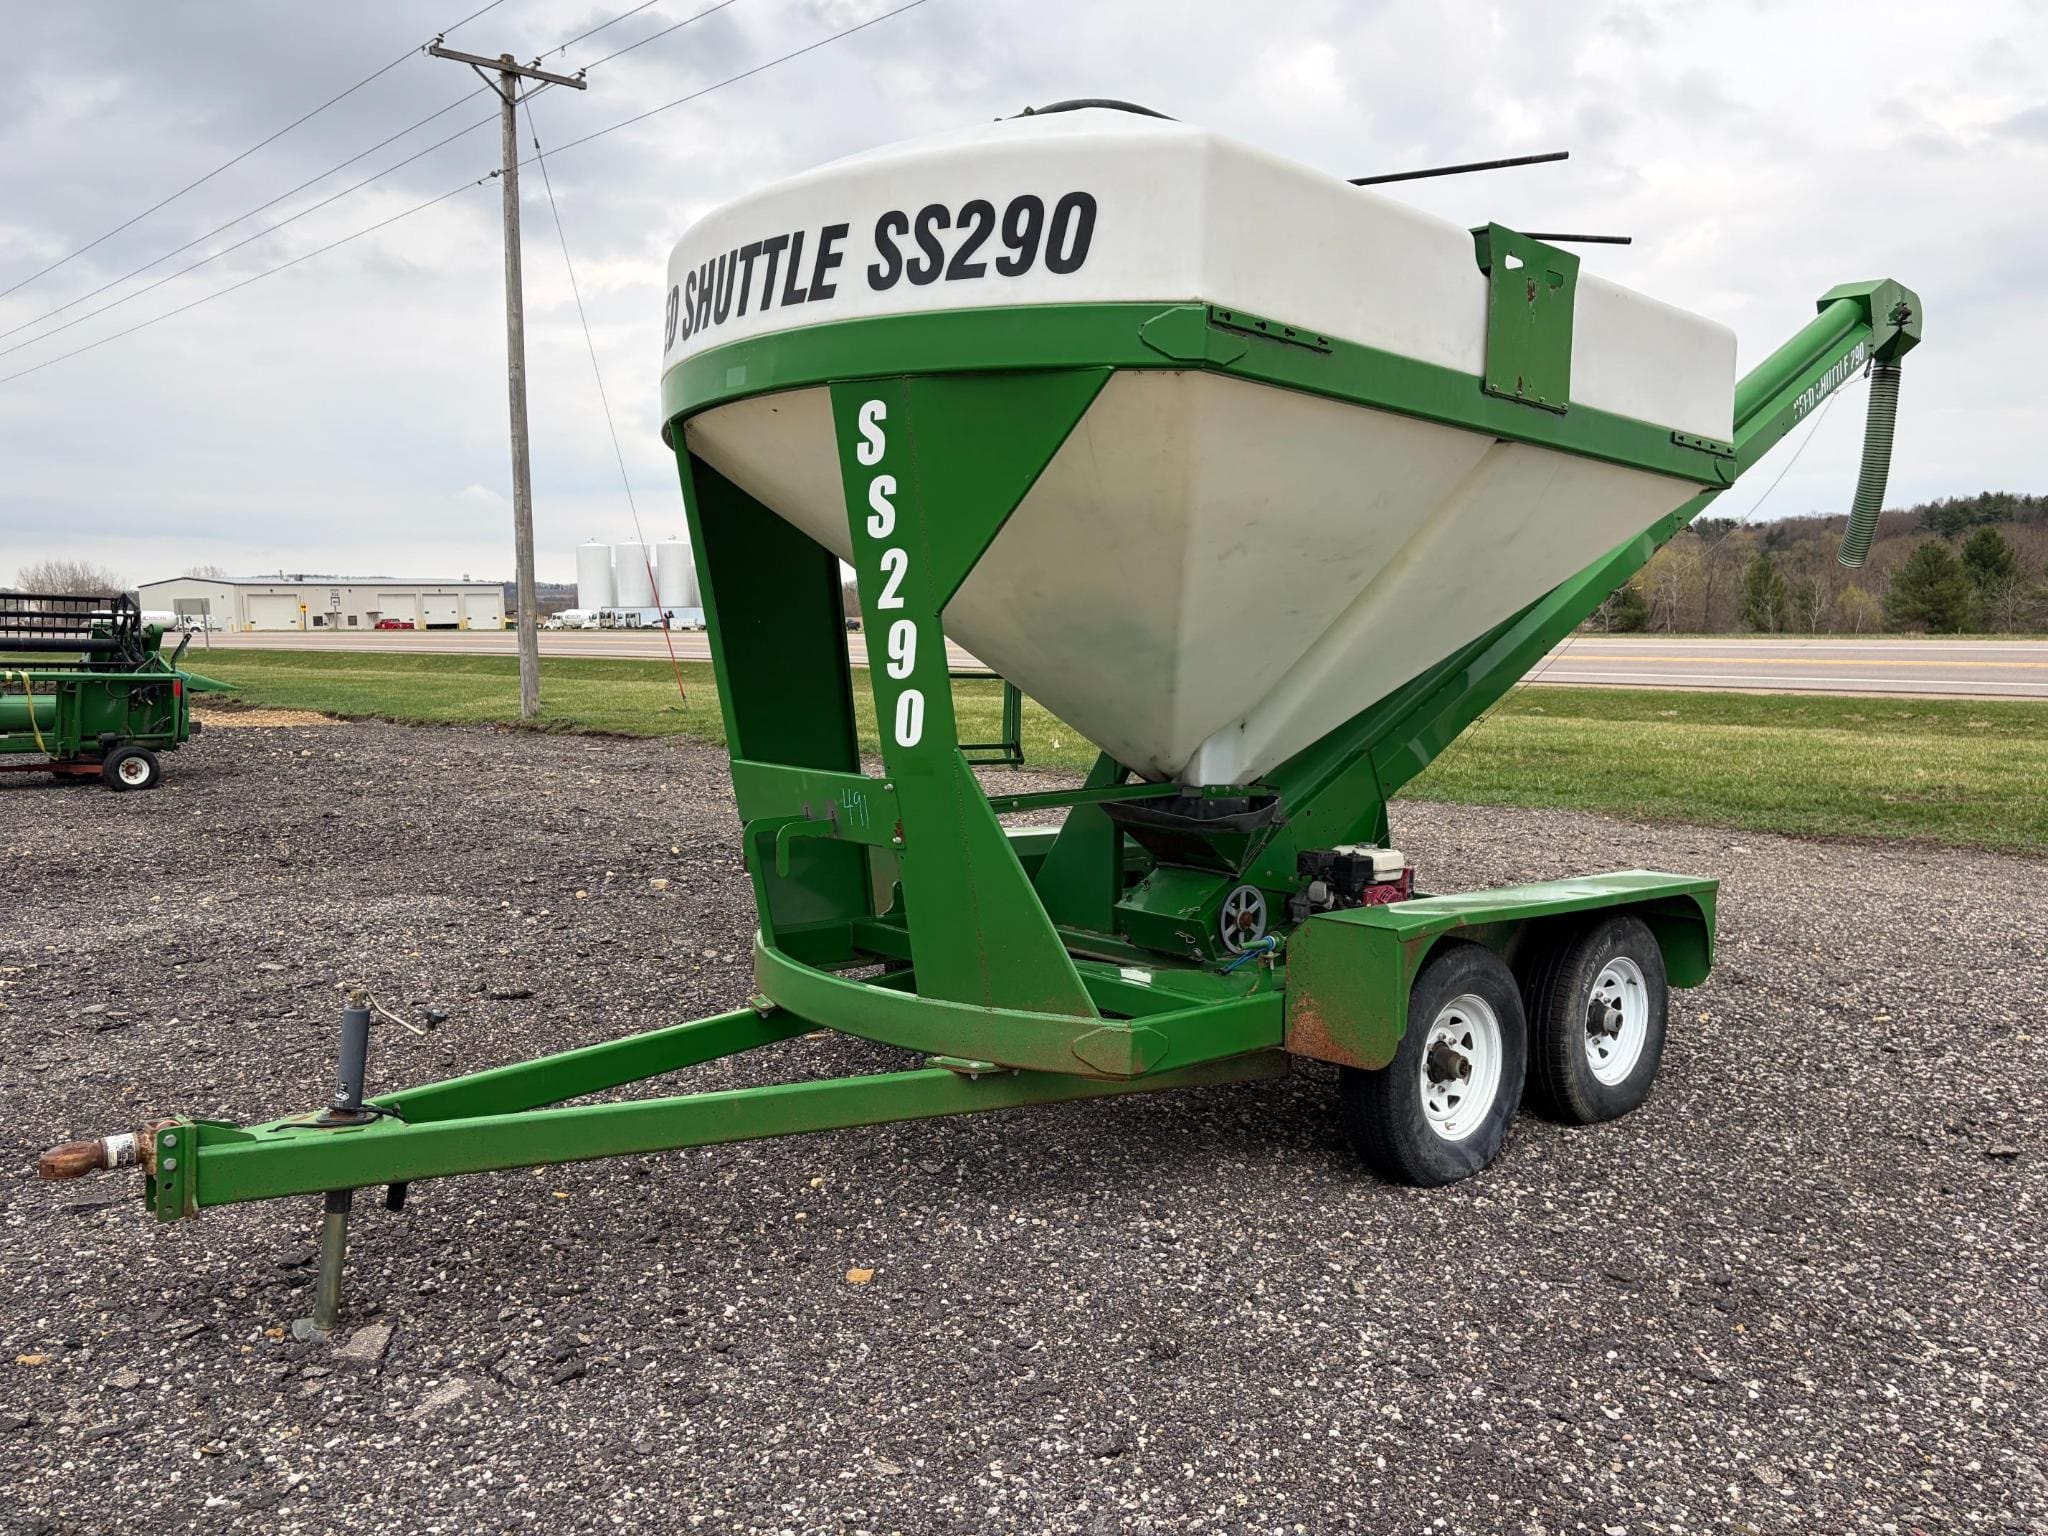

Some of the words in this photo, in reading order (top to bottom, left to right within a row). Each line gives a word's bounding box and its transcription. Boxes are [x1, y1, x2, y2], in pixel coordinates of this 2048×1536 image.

[682, 223, 850, 341] SHUTTLE
[867, 191, 1098, 291] SS290
[842, 788, 869, 830] 491
